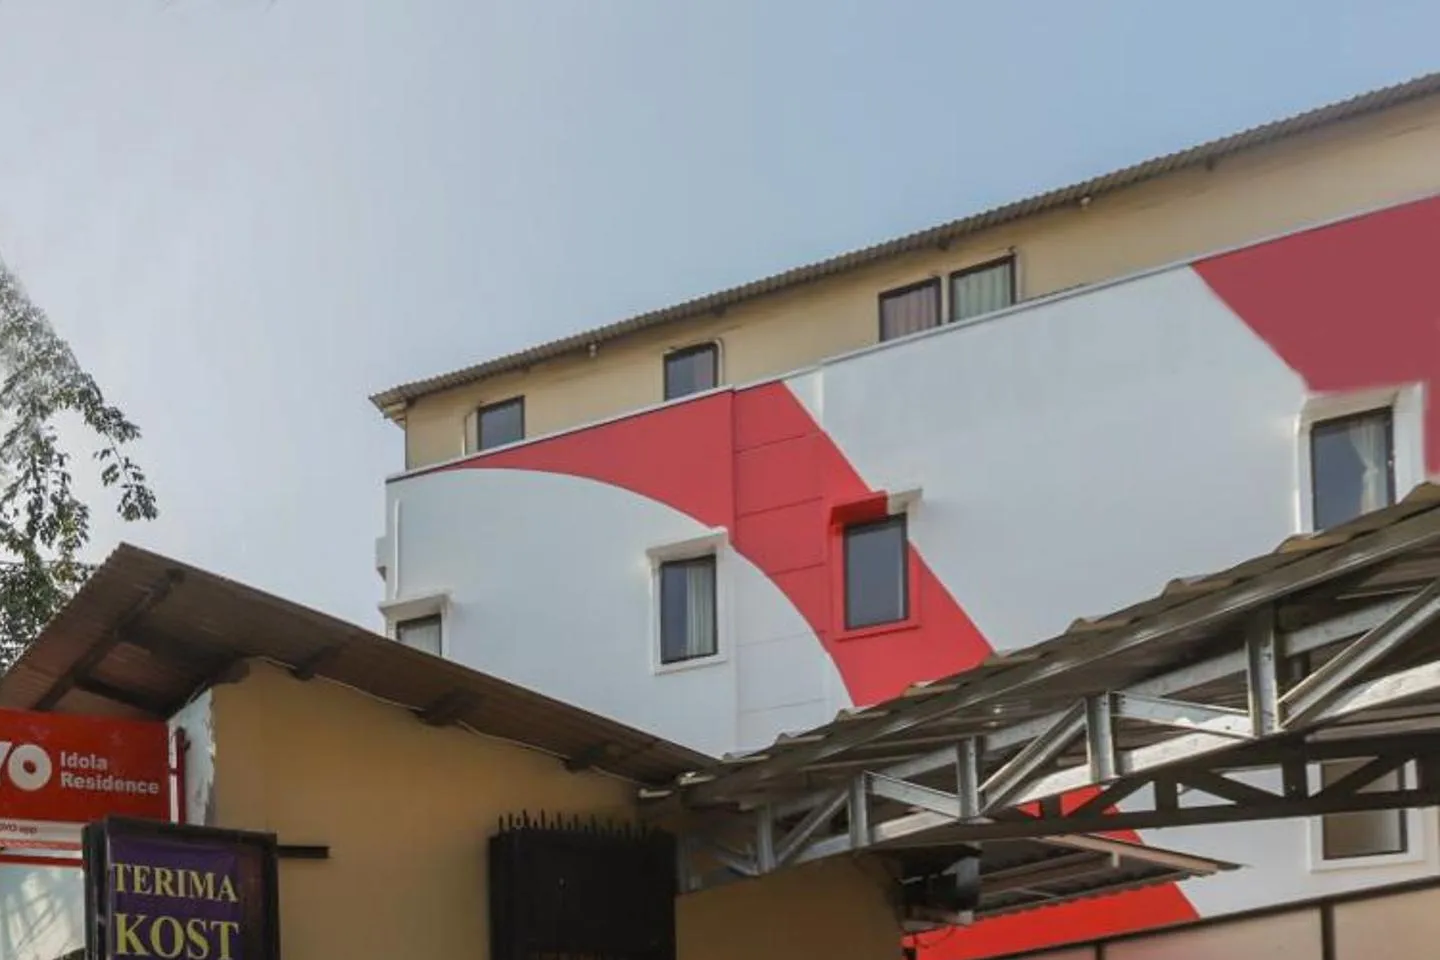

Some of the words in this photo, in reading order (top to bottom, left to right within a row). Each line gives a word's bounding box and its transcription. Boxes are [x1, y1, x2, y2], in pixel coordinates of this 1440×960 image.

[60, 751, 108, 771] Idola
[60, 772, 160, 794] Residence
[112, 862, 239, 903] TERIMA
